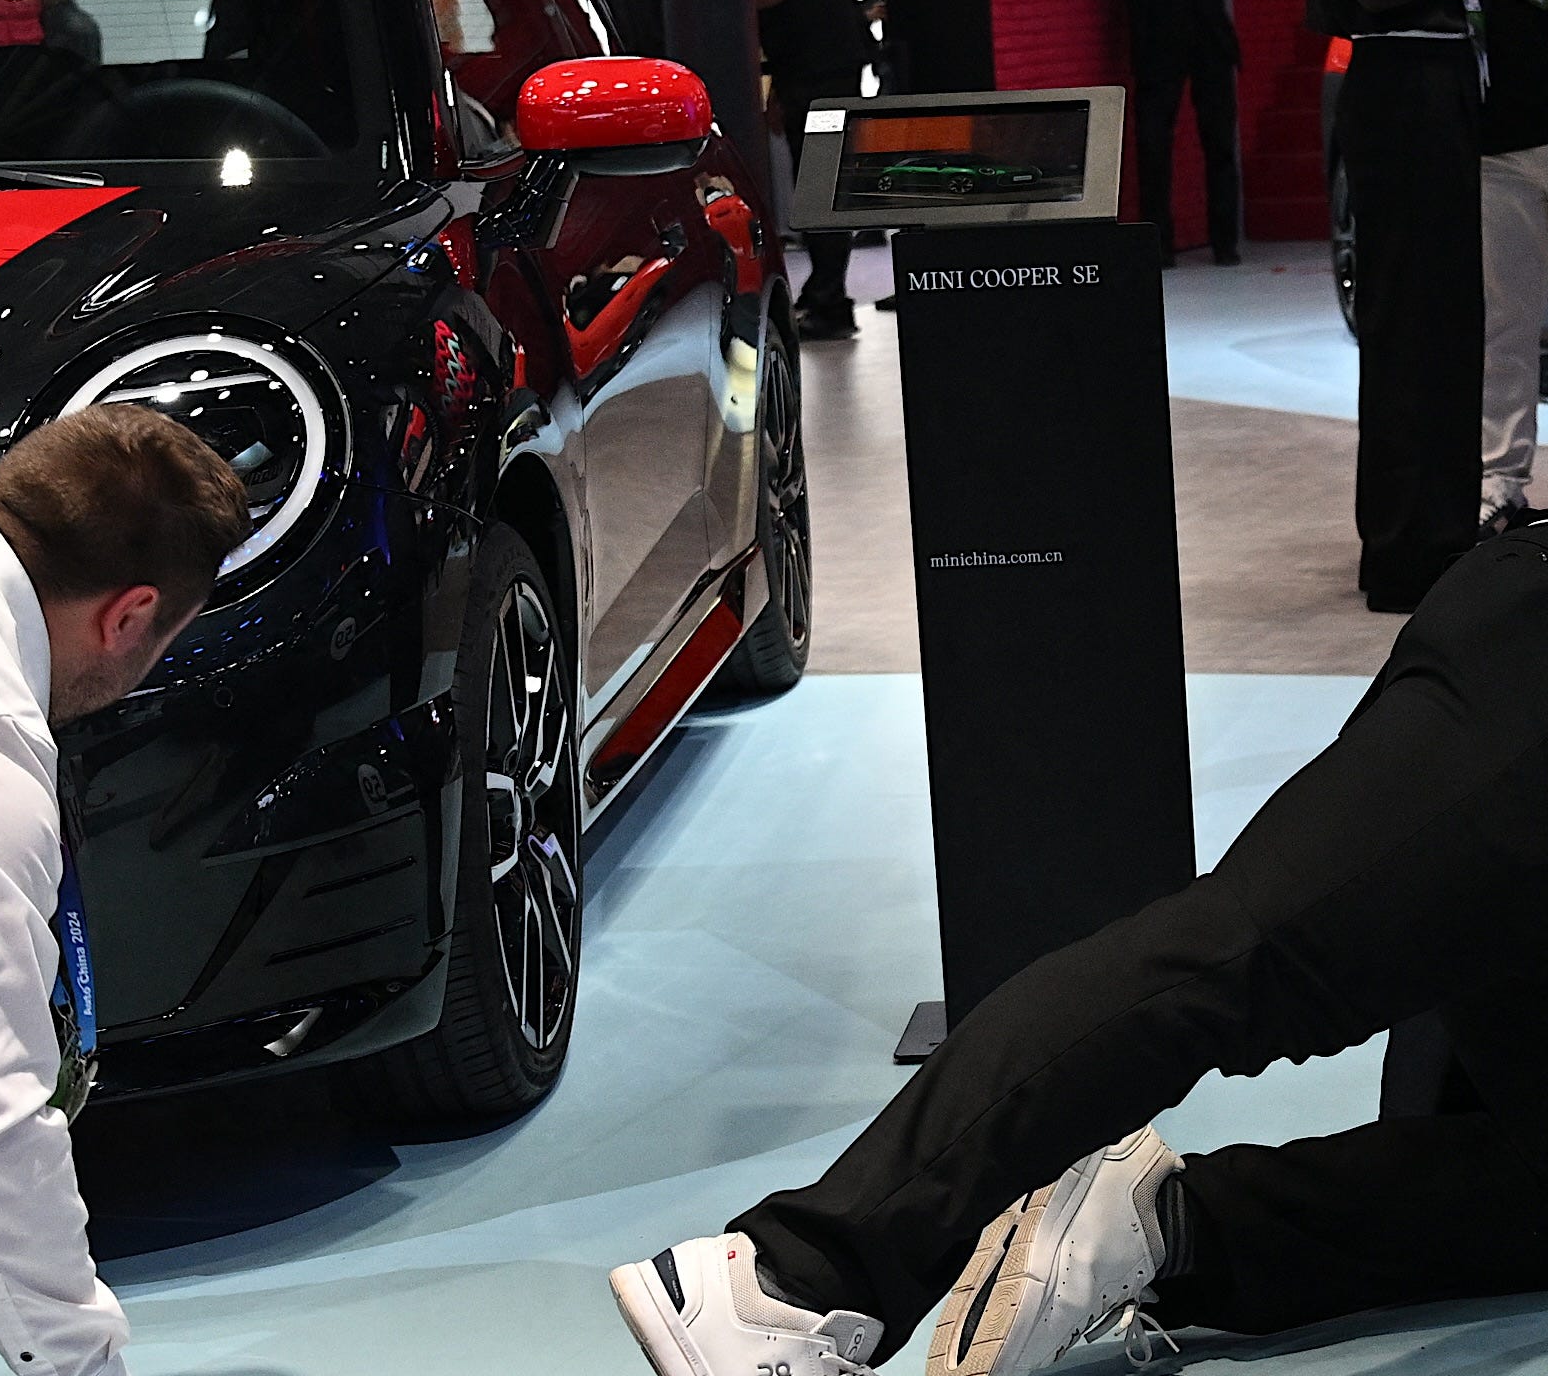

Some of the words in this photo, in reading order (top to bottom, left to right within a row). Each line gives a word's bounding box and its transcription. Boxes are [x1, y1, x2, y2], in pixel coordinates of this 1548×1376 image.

[907, 269, 966, 293] MINI
[969, 265, 1063, 290] COOPER
[1072, 264, 1101, 286] SE
[929, 549, 1064, 570] minichina.com.cn
[66, 910, 84, 945] 2024
[75, 945, 90, 985] China
[82, 986, 93, 1017] Auto
